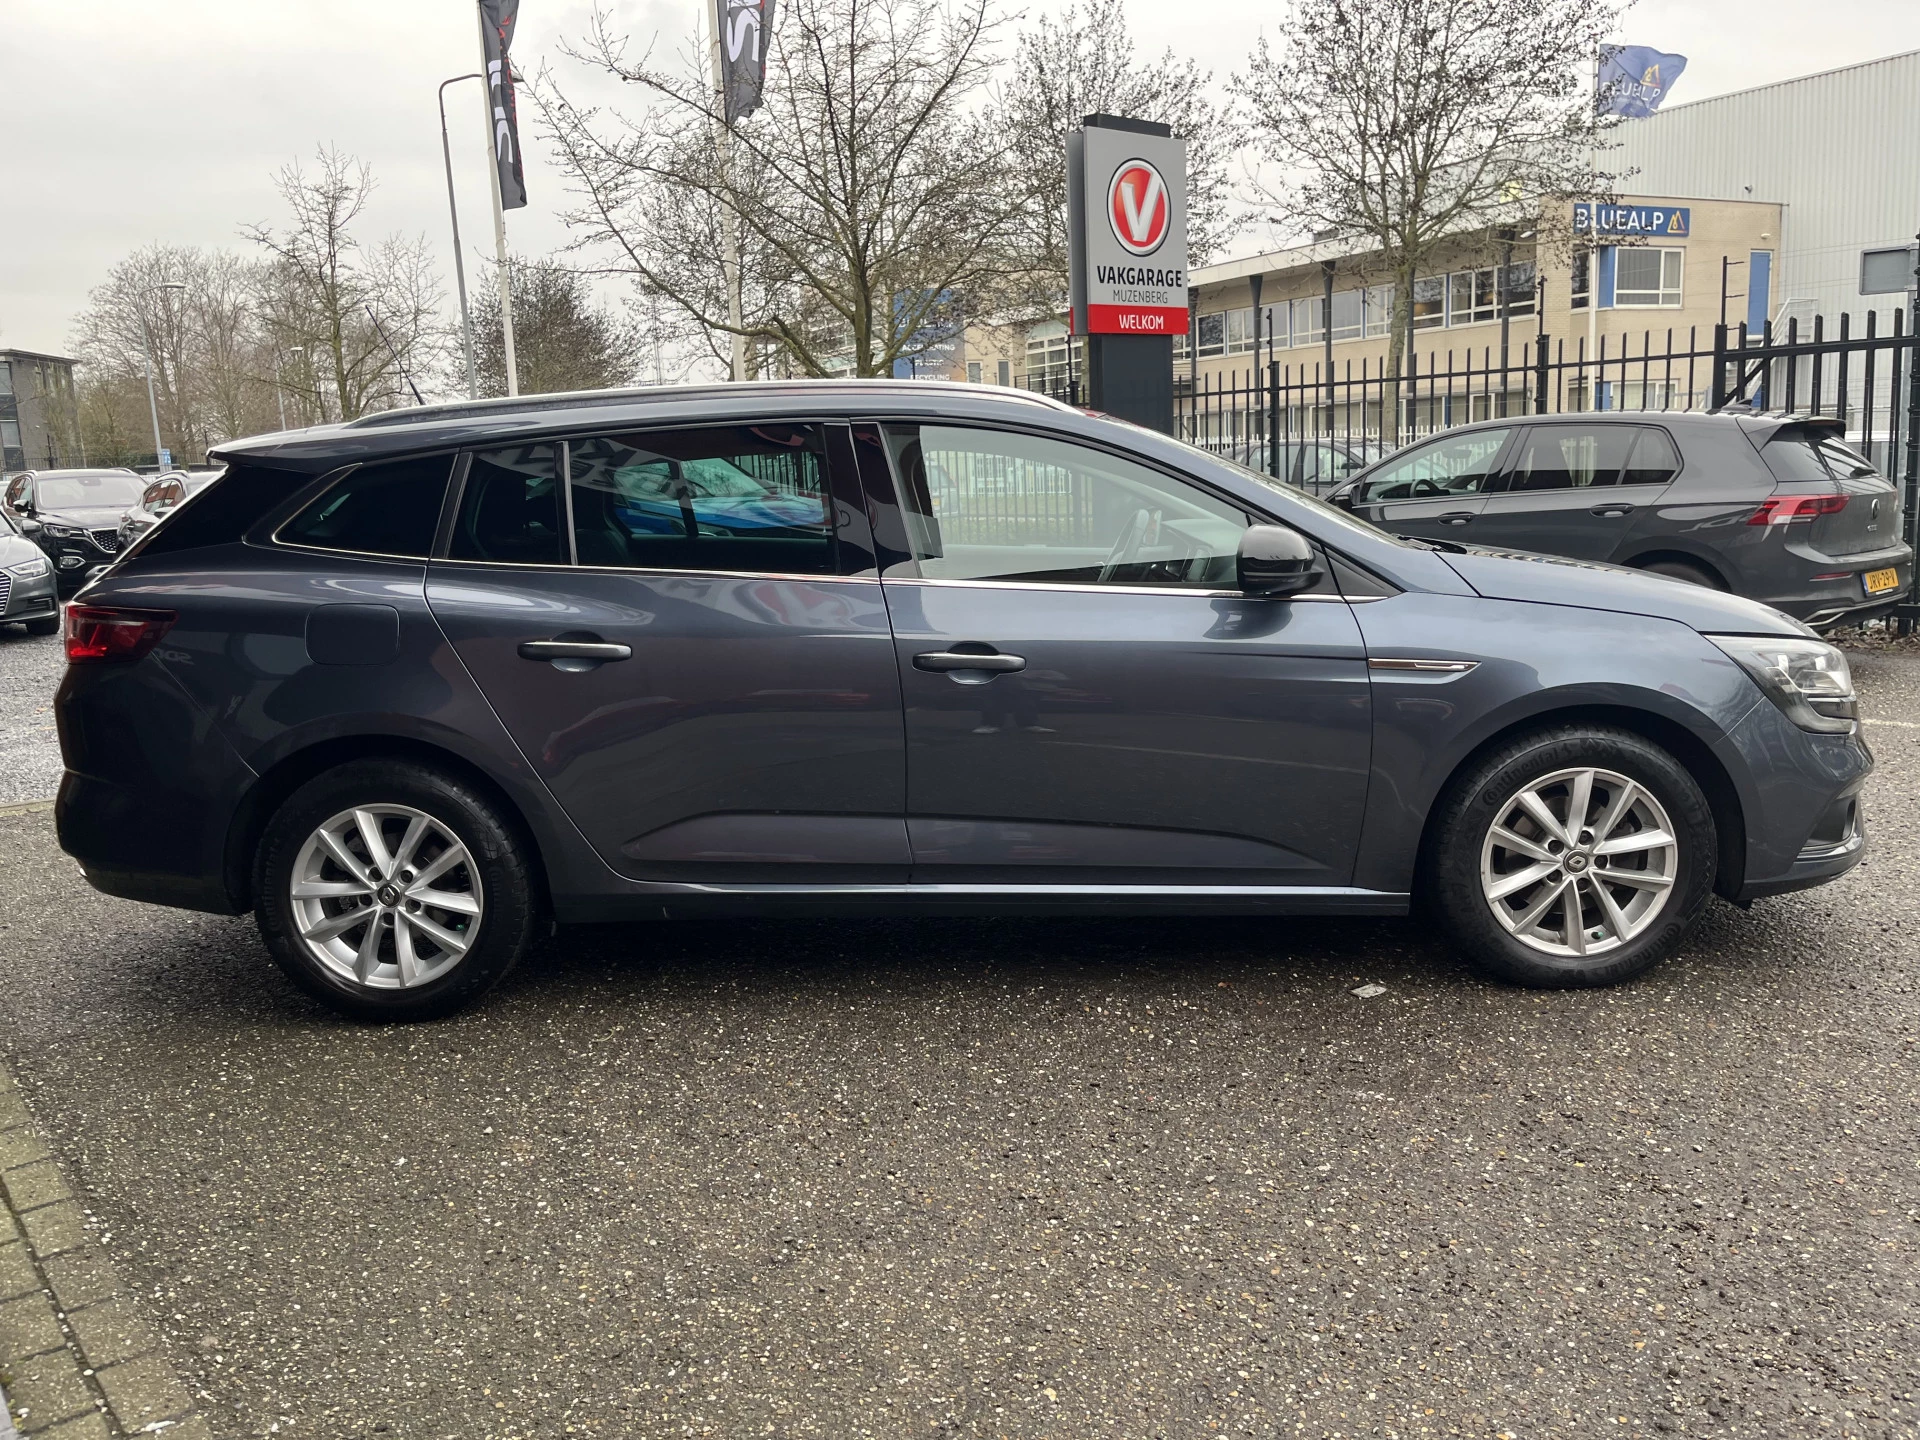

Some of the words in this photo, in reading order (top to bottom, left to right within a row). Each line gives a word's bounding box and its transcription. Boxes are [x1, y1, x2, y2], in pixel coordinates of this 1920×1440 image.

[1576, 208, 1665, 231] BUEALP
[1097, 265, 1183, 288] VAKGARAGE
[1113, 289, 1169, 304] MUZENBERG
[1118, 314, 1165, 330] WELKOM
[1482, 746, 1560, 806] Continental
